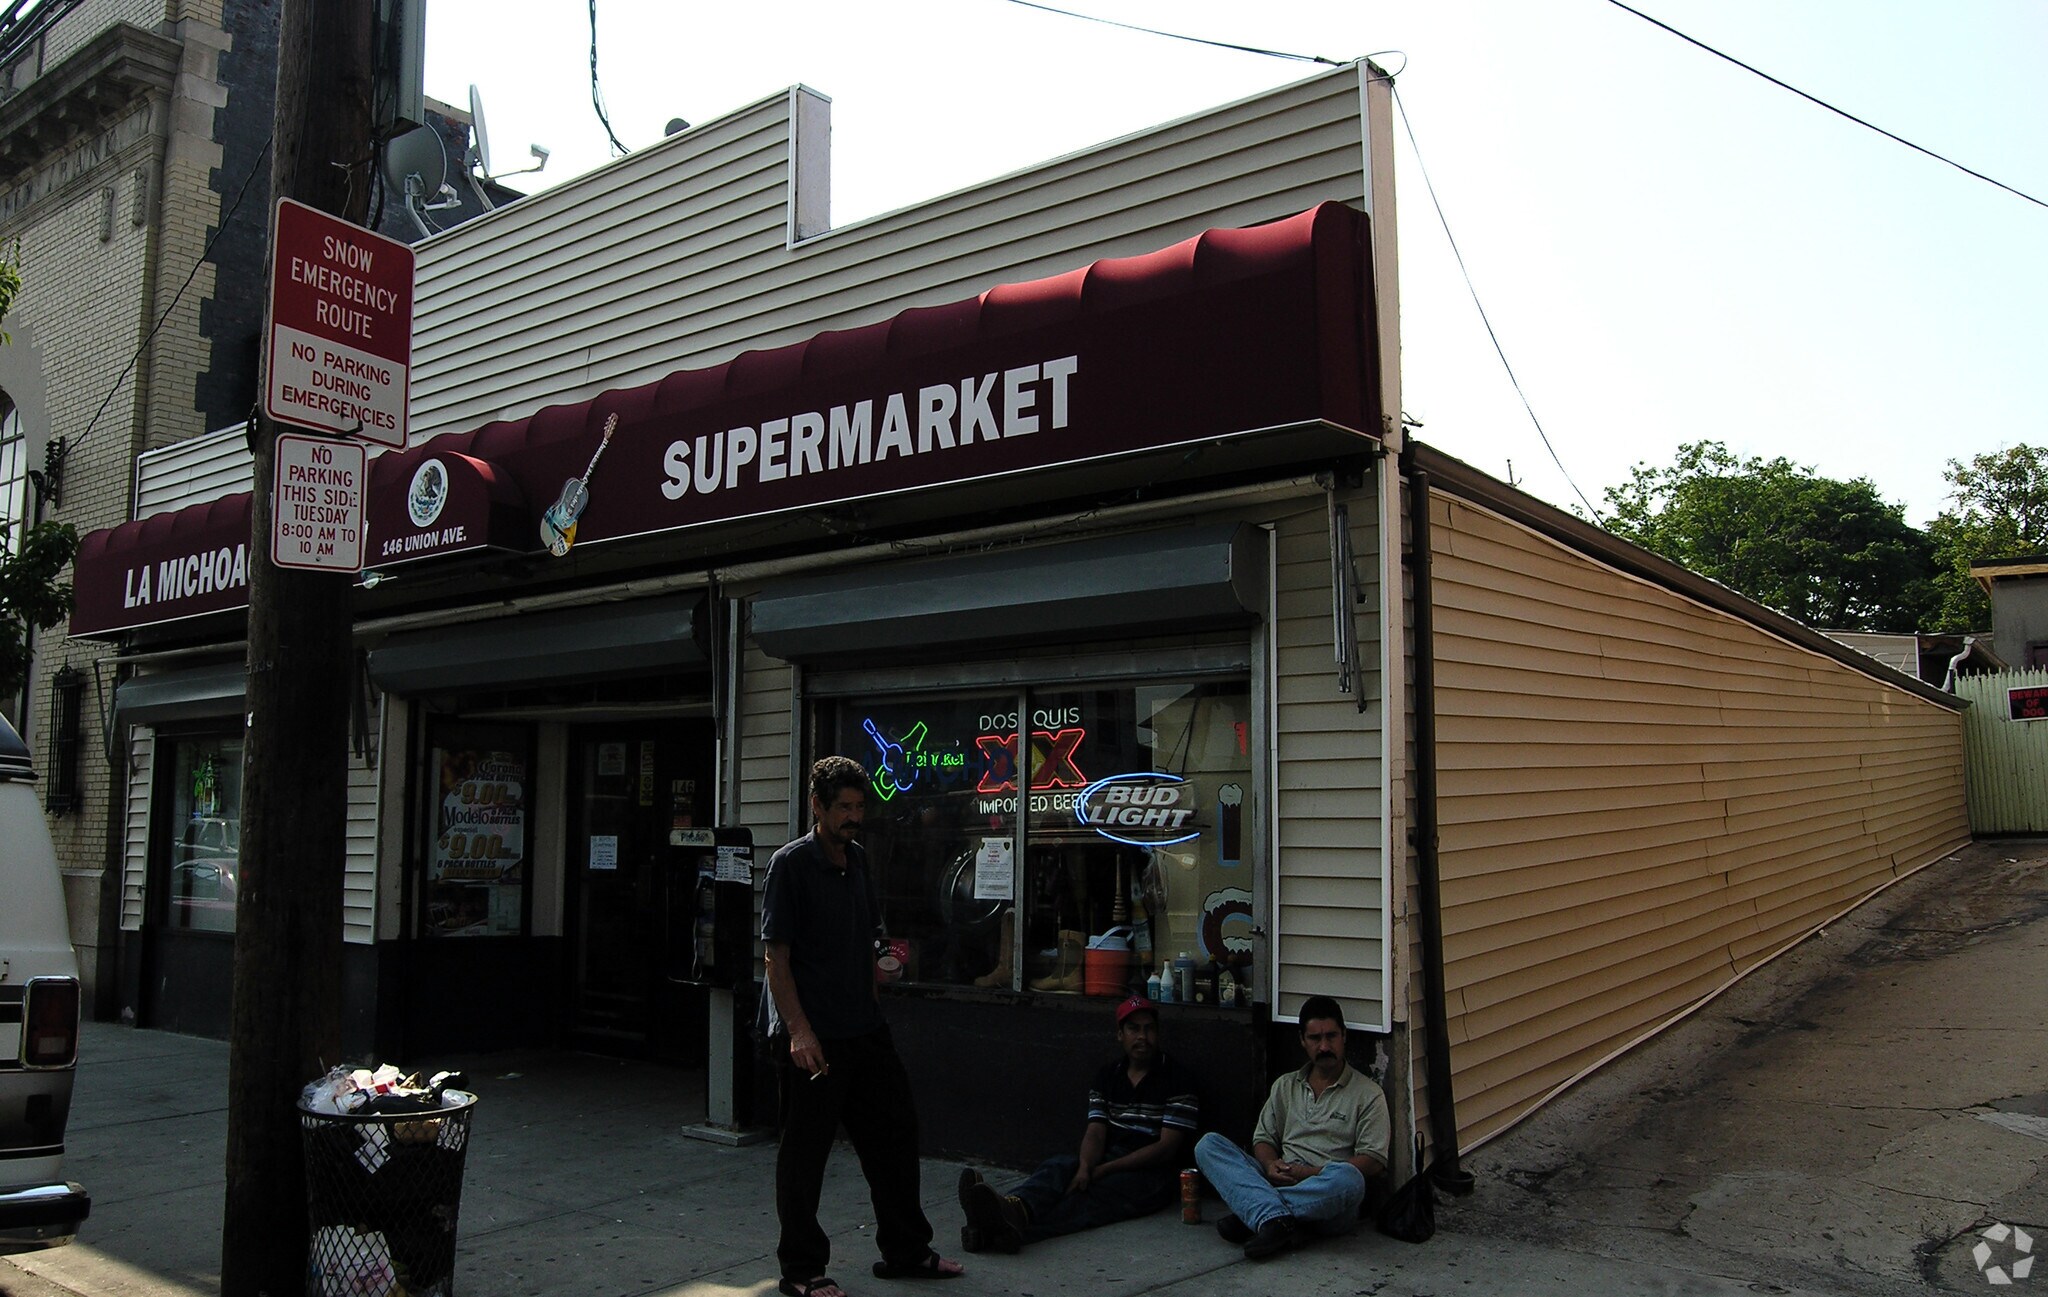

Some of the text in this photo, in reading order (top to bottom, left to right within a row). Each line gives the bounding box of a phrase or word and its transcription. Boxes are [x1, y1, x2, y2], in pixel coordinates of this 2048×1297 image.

[323, 235, 373, 274] SNOW
[291, 256, 398, 315] EMERGENCY
[316, 299, 373, 339] ROUTE
[292, 341, 391, 386] NO PARKING
[312, 370, 371, 401] DURING
[282, 385, 396, 430] EMERGENCIES
[661, 355, 1078, 500] SUPERMARKET
[311, 447, 332, 465] NO
[289, 465, 353, 488] PARKING
[282, 485, 358, 508] THIS SIDE
[294, 504, 349, 525] TUESDAY
[282, 523, 356, 543] 8:00 AM TO
[382, 526, 467, 556] 146 UNION AVE.
[299, 541, 334, 556] 10 AM
[124, 543, 251, 609] LA MICHOA
[2011, 689, 2048, 699] BEWAR
[979, 707, 1081, 731] DOS QUIS
[2023, 708, 2045, 717] DOG
[674, 781, 694, 793] 146
[1105, 785, 1181, 806] BUD
[444, 806, 490, 826] Modelo
[979, 795, 1048, 815] IMPOED
[489, 816, 521, 825] BOTTLES
[1089, 806, 1194, 828] LIGHT
[438, 833, 504, 859] $9.00
[443, 860, 465, 868] PACK
[465, 860, 497, 869] BOTTLES
